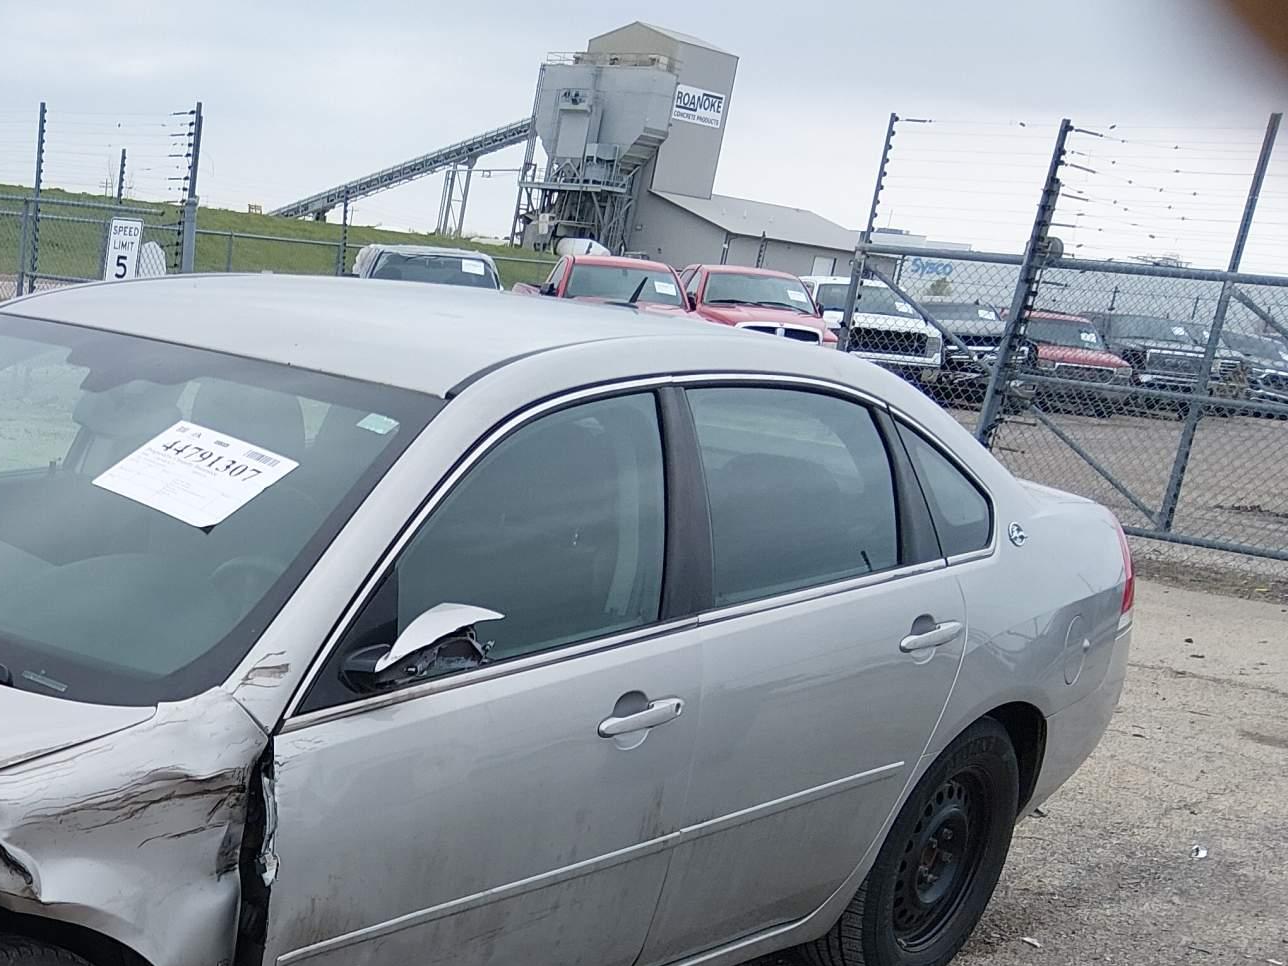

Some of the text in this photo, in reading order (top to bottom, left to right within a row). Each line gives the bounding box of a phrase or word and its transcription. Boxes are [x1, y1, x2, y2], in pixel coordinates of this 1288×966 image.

[676, 90, 723, 114] ROANOKE
[113, 225, 139, 236] SPEED
[113, 240, 135, 251] LIMIT
[114, 254, 128, 279] 5
[162, 440, 263, 481] 44791307
